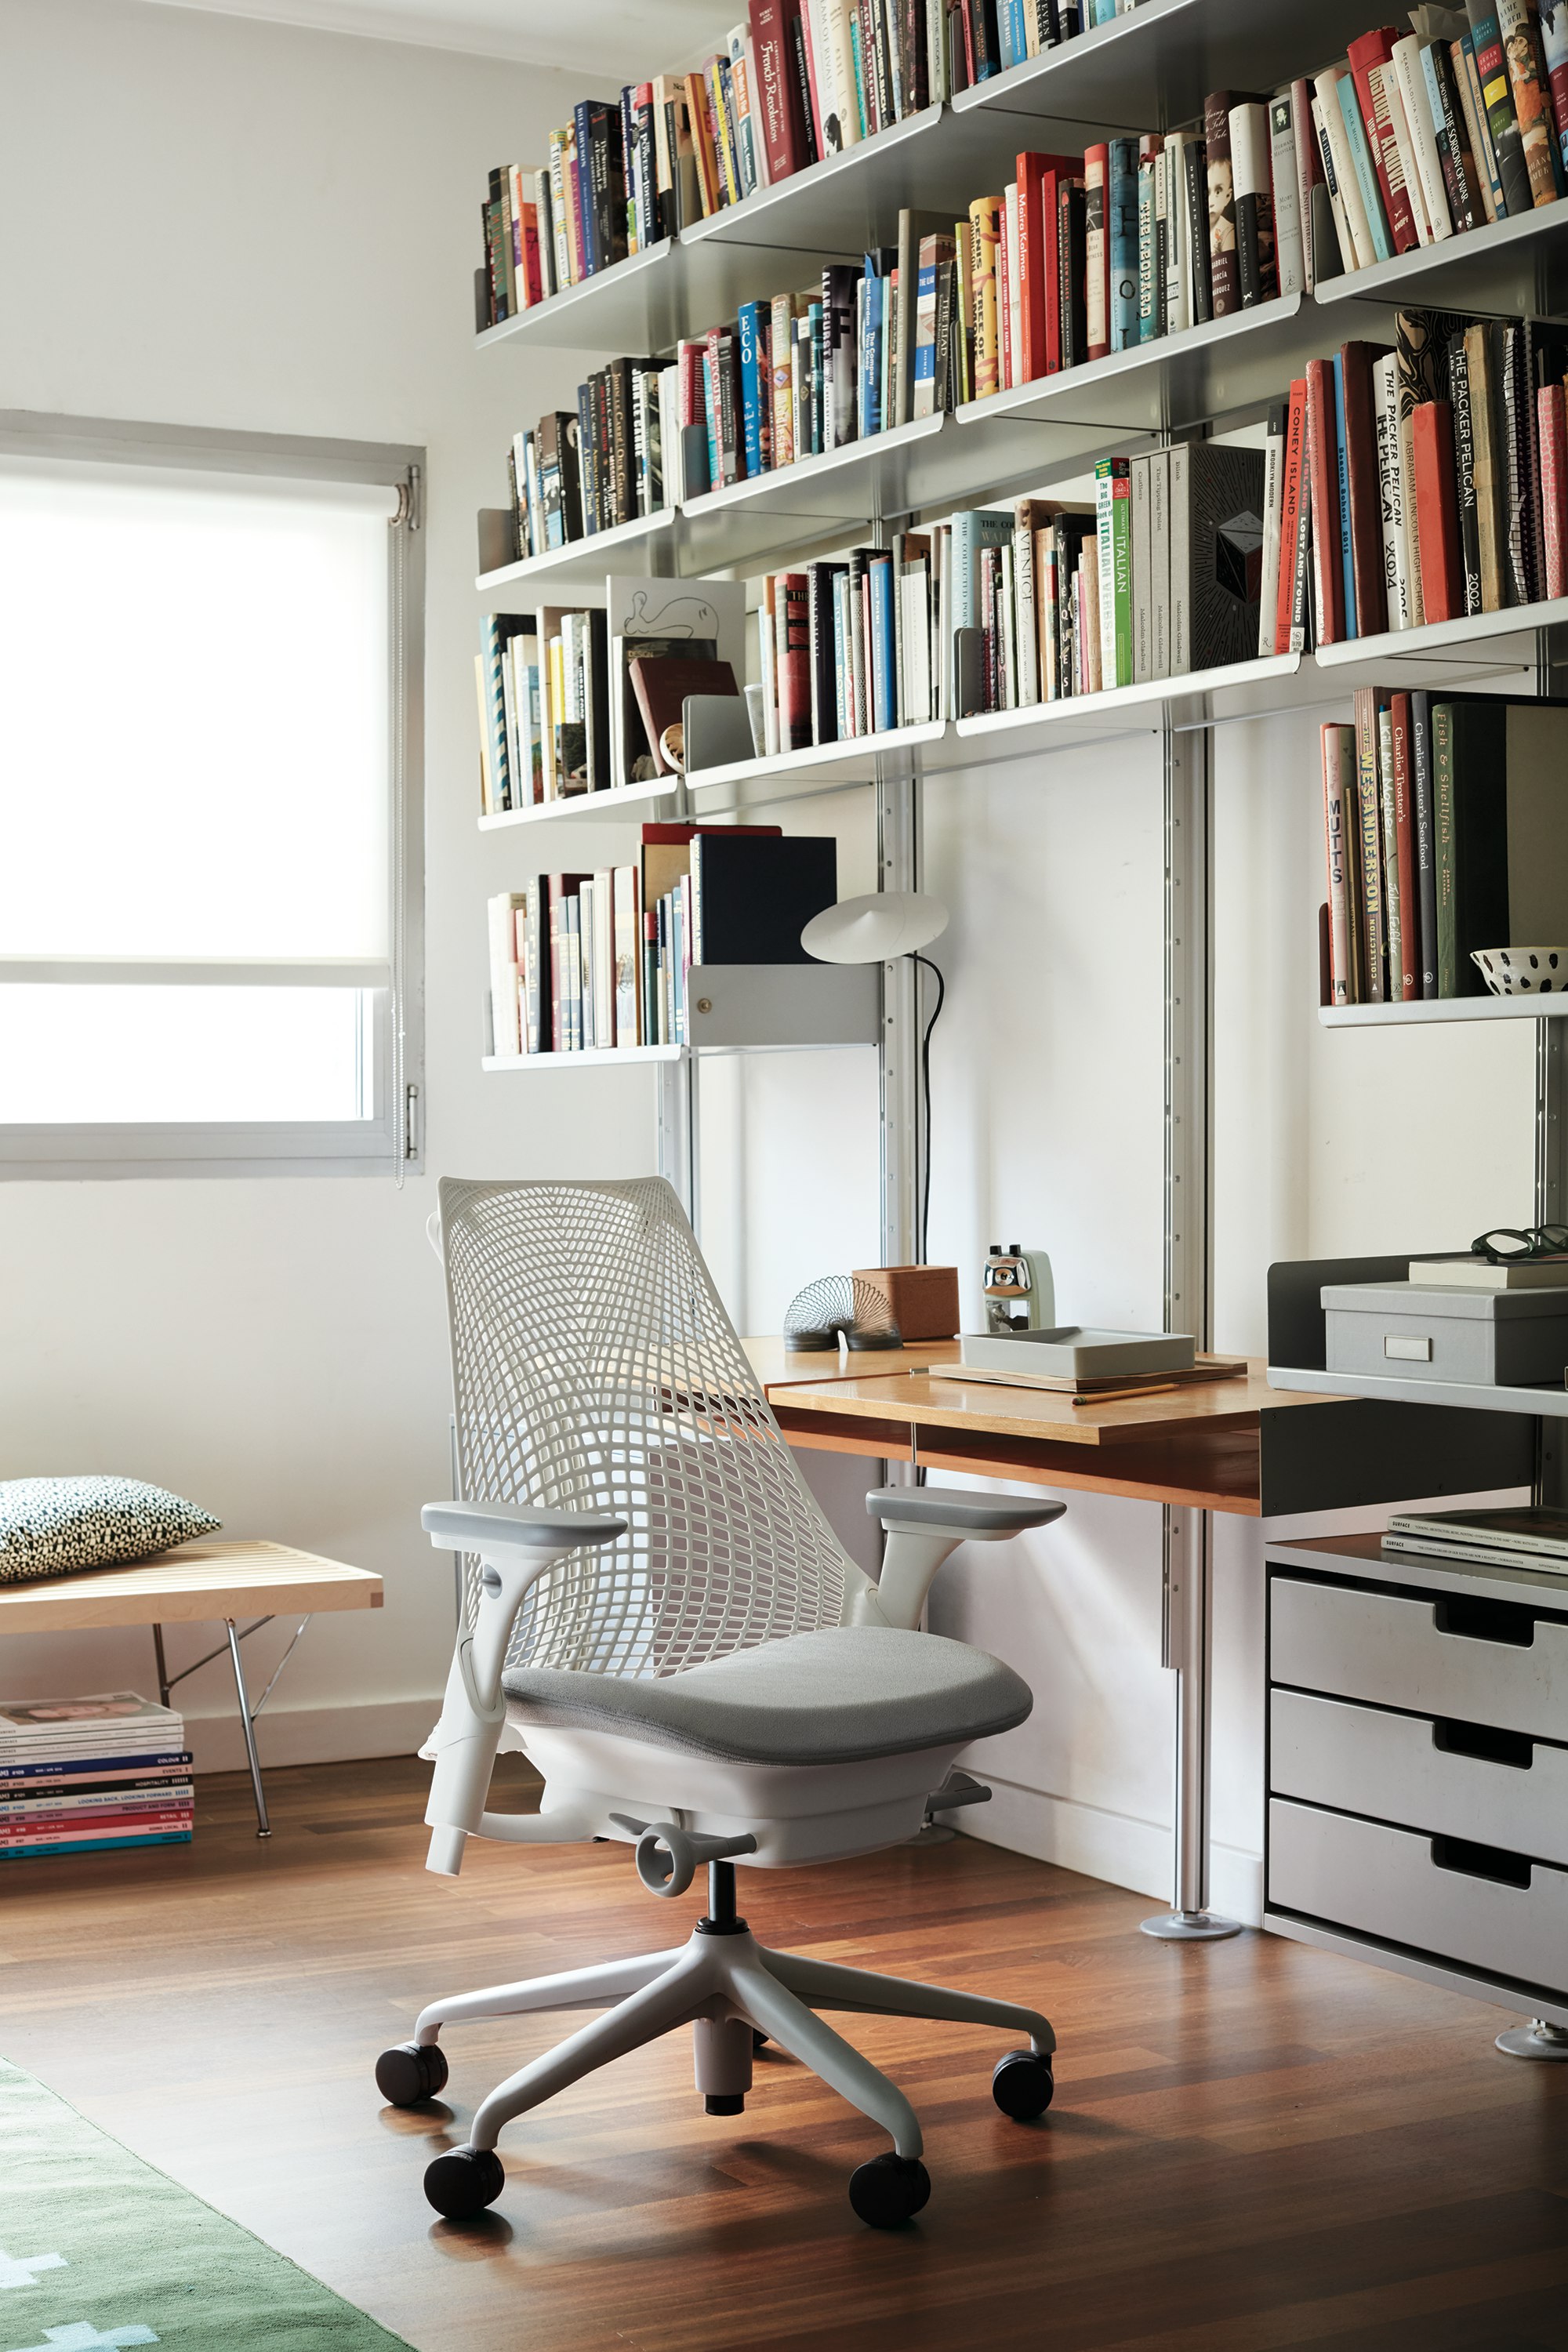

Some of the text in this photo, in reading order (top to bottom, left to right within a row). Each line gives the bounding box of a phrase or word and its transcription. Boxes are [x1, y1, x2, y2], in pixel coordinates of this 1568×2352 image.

[1403, 52, 1411, 85] READING
[1409, 87, 1417, 113] LOLITA
[1416, 126, 1425, 157] TEHRAN
[1444, 111, 1454, 128] THE
[1274, 139, 1294, 151] HERMAN
[1320, 134, 1336, 193] Millhauser
[1347, 108, 1375, 212] RICK MOODY DEMONOLOGY
[1448, 127, 1461, 167] SORROW
[1455, 167, 1464, 180] OF
[1459, 180, 1468, 205] WAR
[1193, 209, 1196, 220] IN
[1279, 194, 1293, 204] MOBY
[1280, 204, 1293, 212] DICK
[1394, 215, 1410, 233] KNOPF
[1140, 200, 1152, 318] THE LEOPARD
[741, 315, 752, 364] ECO
[822, 272, 832, 359] ALAN FURST
[978, 336, 984, 359] OF
[1455, 349, 1466, 377] THE
[1385, 370, 1395, 397] THE
[1387, 405, 1398, 460] PACKER
[1456, 382, 1471, 439] PACKER
[1288, 407, 1300, 514] CONEY ISLAND
[1461, 444, 1475, 507] PELICAN
[1391, 466, 1402, 526] PELICAN
[1405, 441, 1416, 492] ABRAHAM
[1414, 576, 1423, 620] SCHOOL
[1019, 533, 1032, 604] VENICE
[1101, 522, 1112, 630] ITALIAN VERBS
[1116, 536, 1127, 593] ITALIAN
[1385, 542, 1397, 589] 2004
[1468, 573, 1480, 608] 2002
[1395, 727, 1403, 772] Charlie
[1438, 713, 1446, 745] Fish
[1360, 751, 1374, 800] WES
[1440, 753, 1447, 765] &
[1417, 771, 1426, 821] Trotter's
[1329, 800, 1343, 884] MUTTS
[1363, 804, 1379, 915] ANDERSON
[1381, 725, 1401, 956] Kill My Mother Jules Feiffer
[1386, 1540, 1404, 1548] SURFACE
